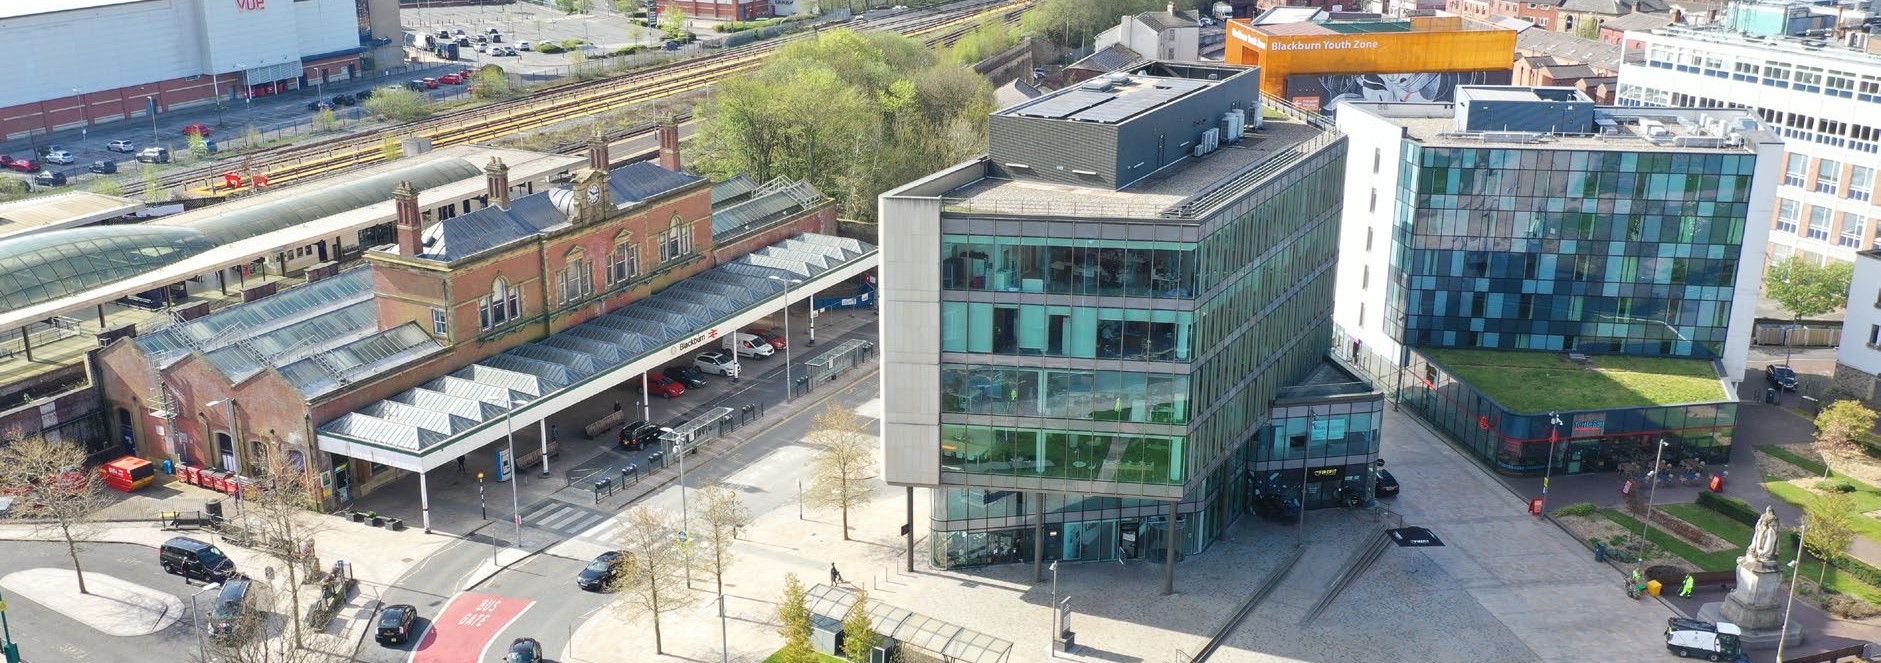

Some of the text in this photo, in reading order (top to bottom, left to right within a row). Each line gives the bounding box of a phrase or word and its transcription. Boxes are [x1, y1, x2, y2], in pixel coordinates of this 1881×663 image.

[1271, 40, 1378, 51] Blackburn Youth Zone
[679, 334, 706, 351] Blackburn
[476, 599, 502, 612] BUS
[458, 613, 491, 626] GATE
